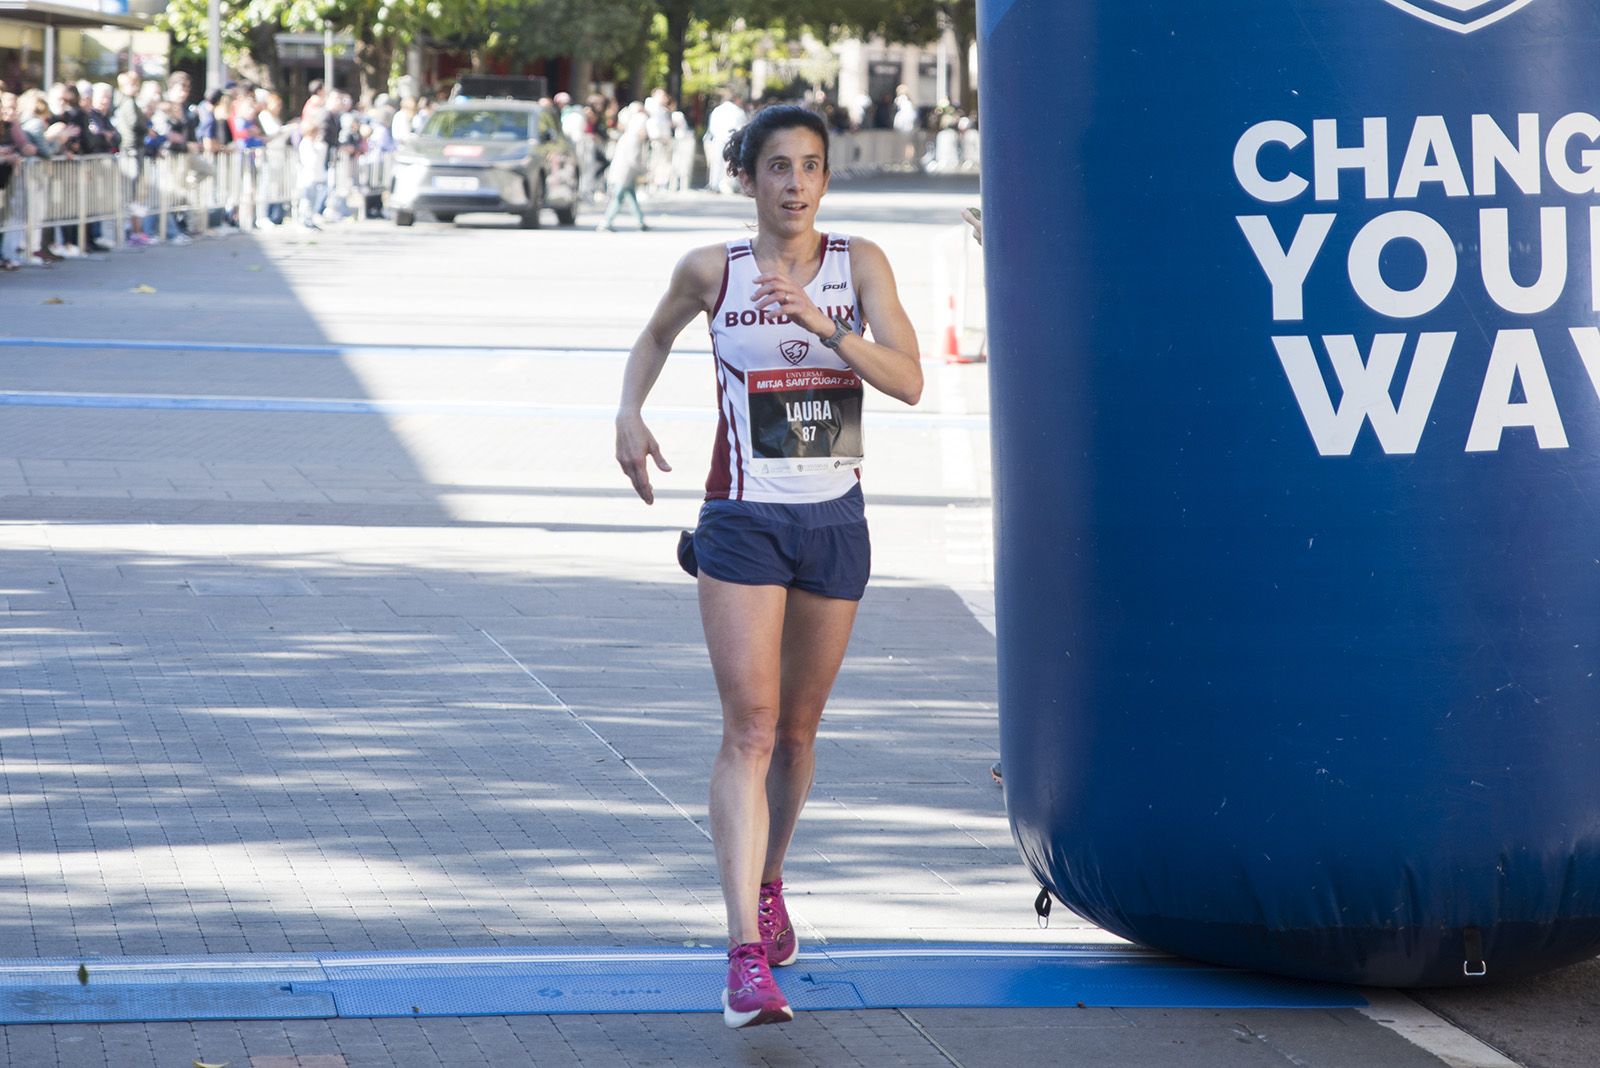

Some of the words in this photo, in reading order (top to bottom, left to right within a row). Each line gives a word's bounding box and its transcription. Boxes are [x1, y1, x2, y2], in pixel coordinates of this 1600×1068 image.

[1235, 206, 1600, 321] YOU
[785, 370, 824, 378] UNIVERSAL
[756, 379, 784, 389] MITJA
[785, 377, 810, 387] SANT
[811, 376, 843, 385] CUGAT
[786, 399, 832, 422] LAURA
[802, 426, 817, 442] 87
